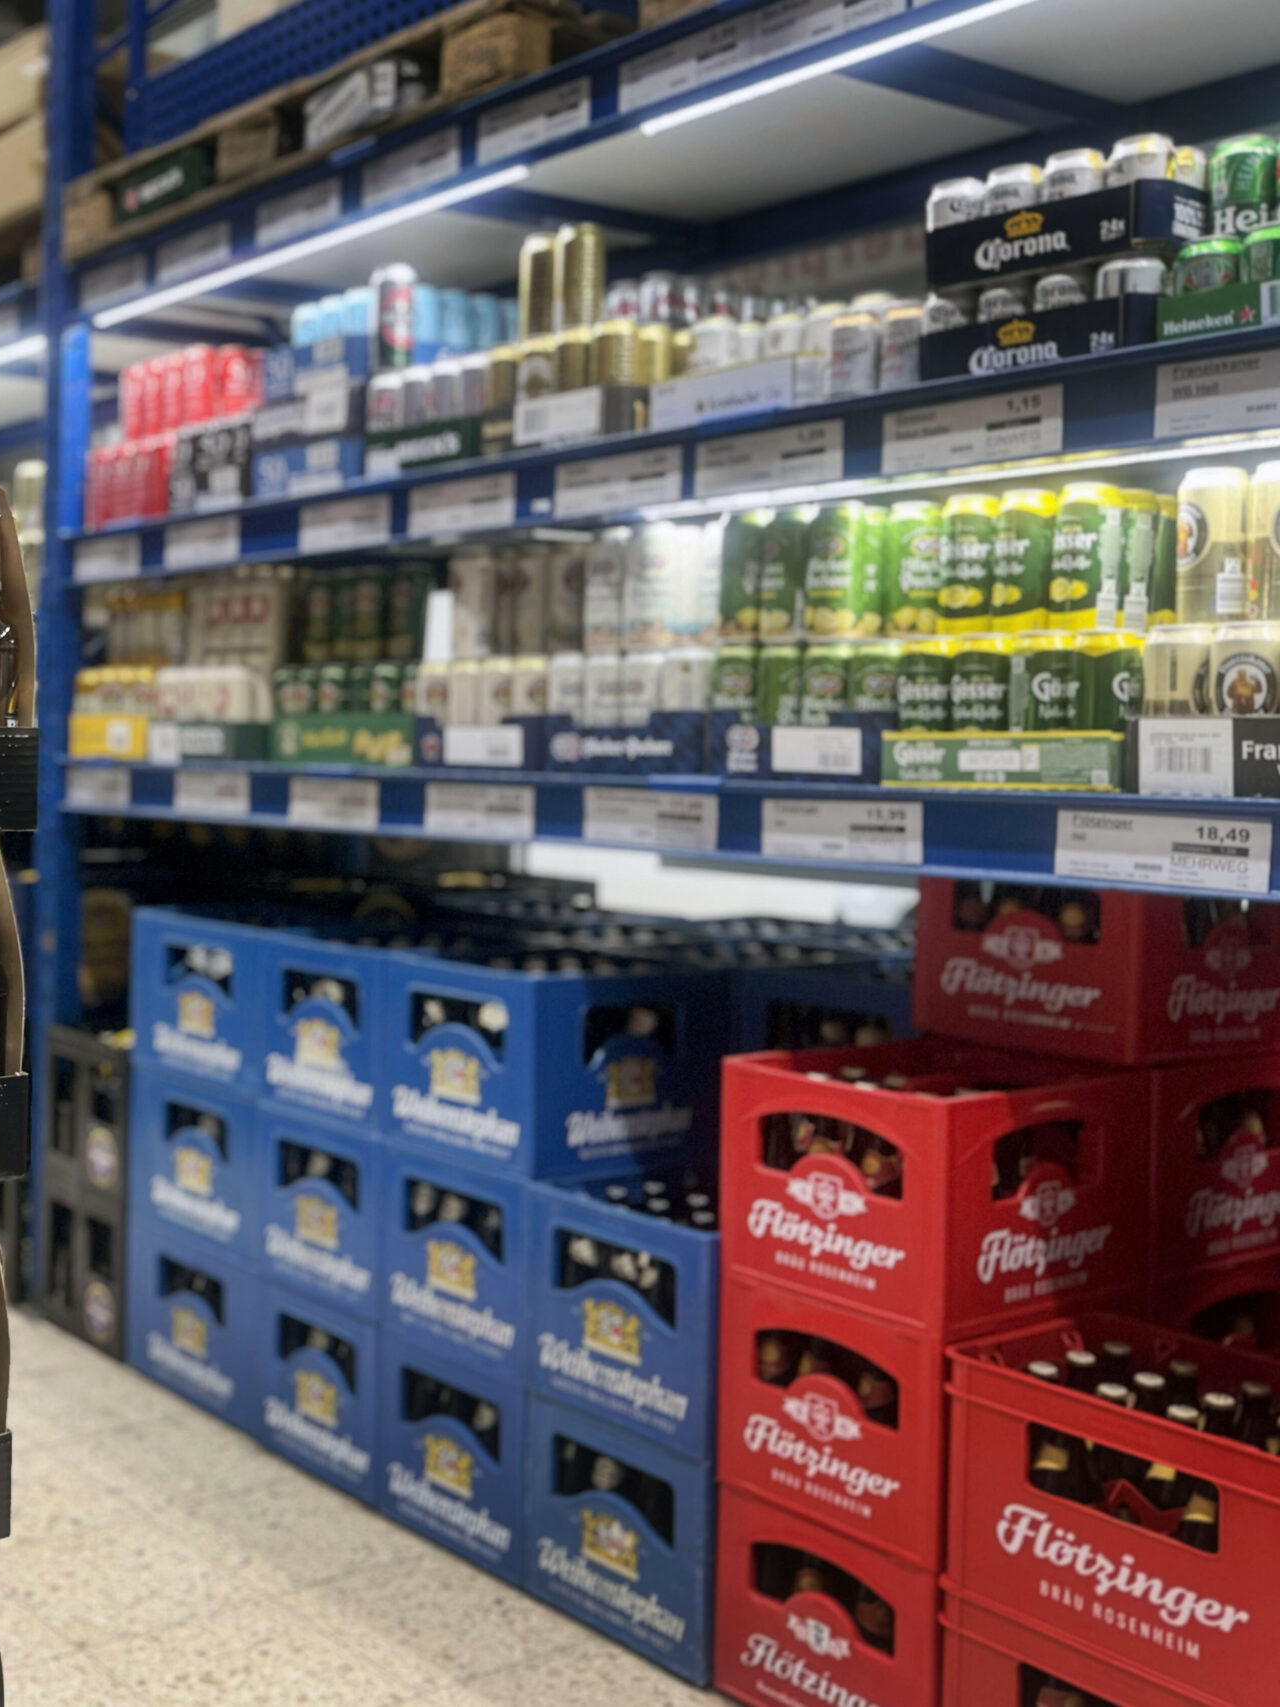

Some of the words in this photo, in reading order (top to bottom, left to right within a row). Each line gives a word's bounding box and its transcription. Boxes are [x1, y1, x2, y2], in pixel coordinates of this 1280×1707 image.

[974, 231, 1068, 271] Corona
[1163, 310, 1234, 336] Heineken
[968, 340, 1059, 377] Corona
[1241, 740, 1280, 760] Fra
[1196, 826, 1250, 843] 18,49
[1171, 855, 1248, 873] MEHRWEG
[940, 956, 1102, 1012] Flötzinger
[748, 1197, 906, 1271] Flötzinger
[976, 1223, 1112, 1283] Flötzinger
[743, 1414, 900, 1499] Flötzinger
[996, 1503, 1250, 1634] Flötzinger
[1039, 1580, 1085, 1613] BRÄU
[1093, 1602, 1200, 1660] ROSENHEIM
